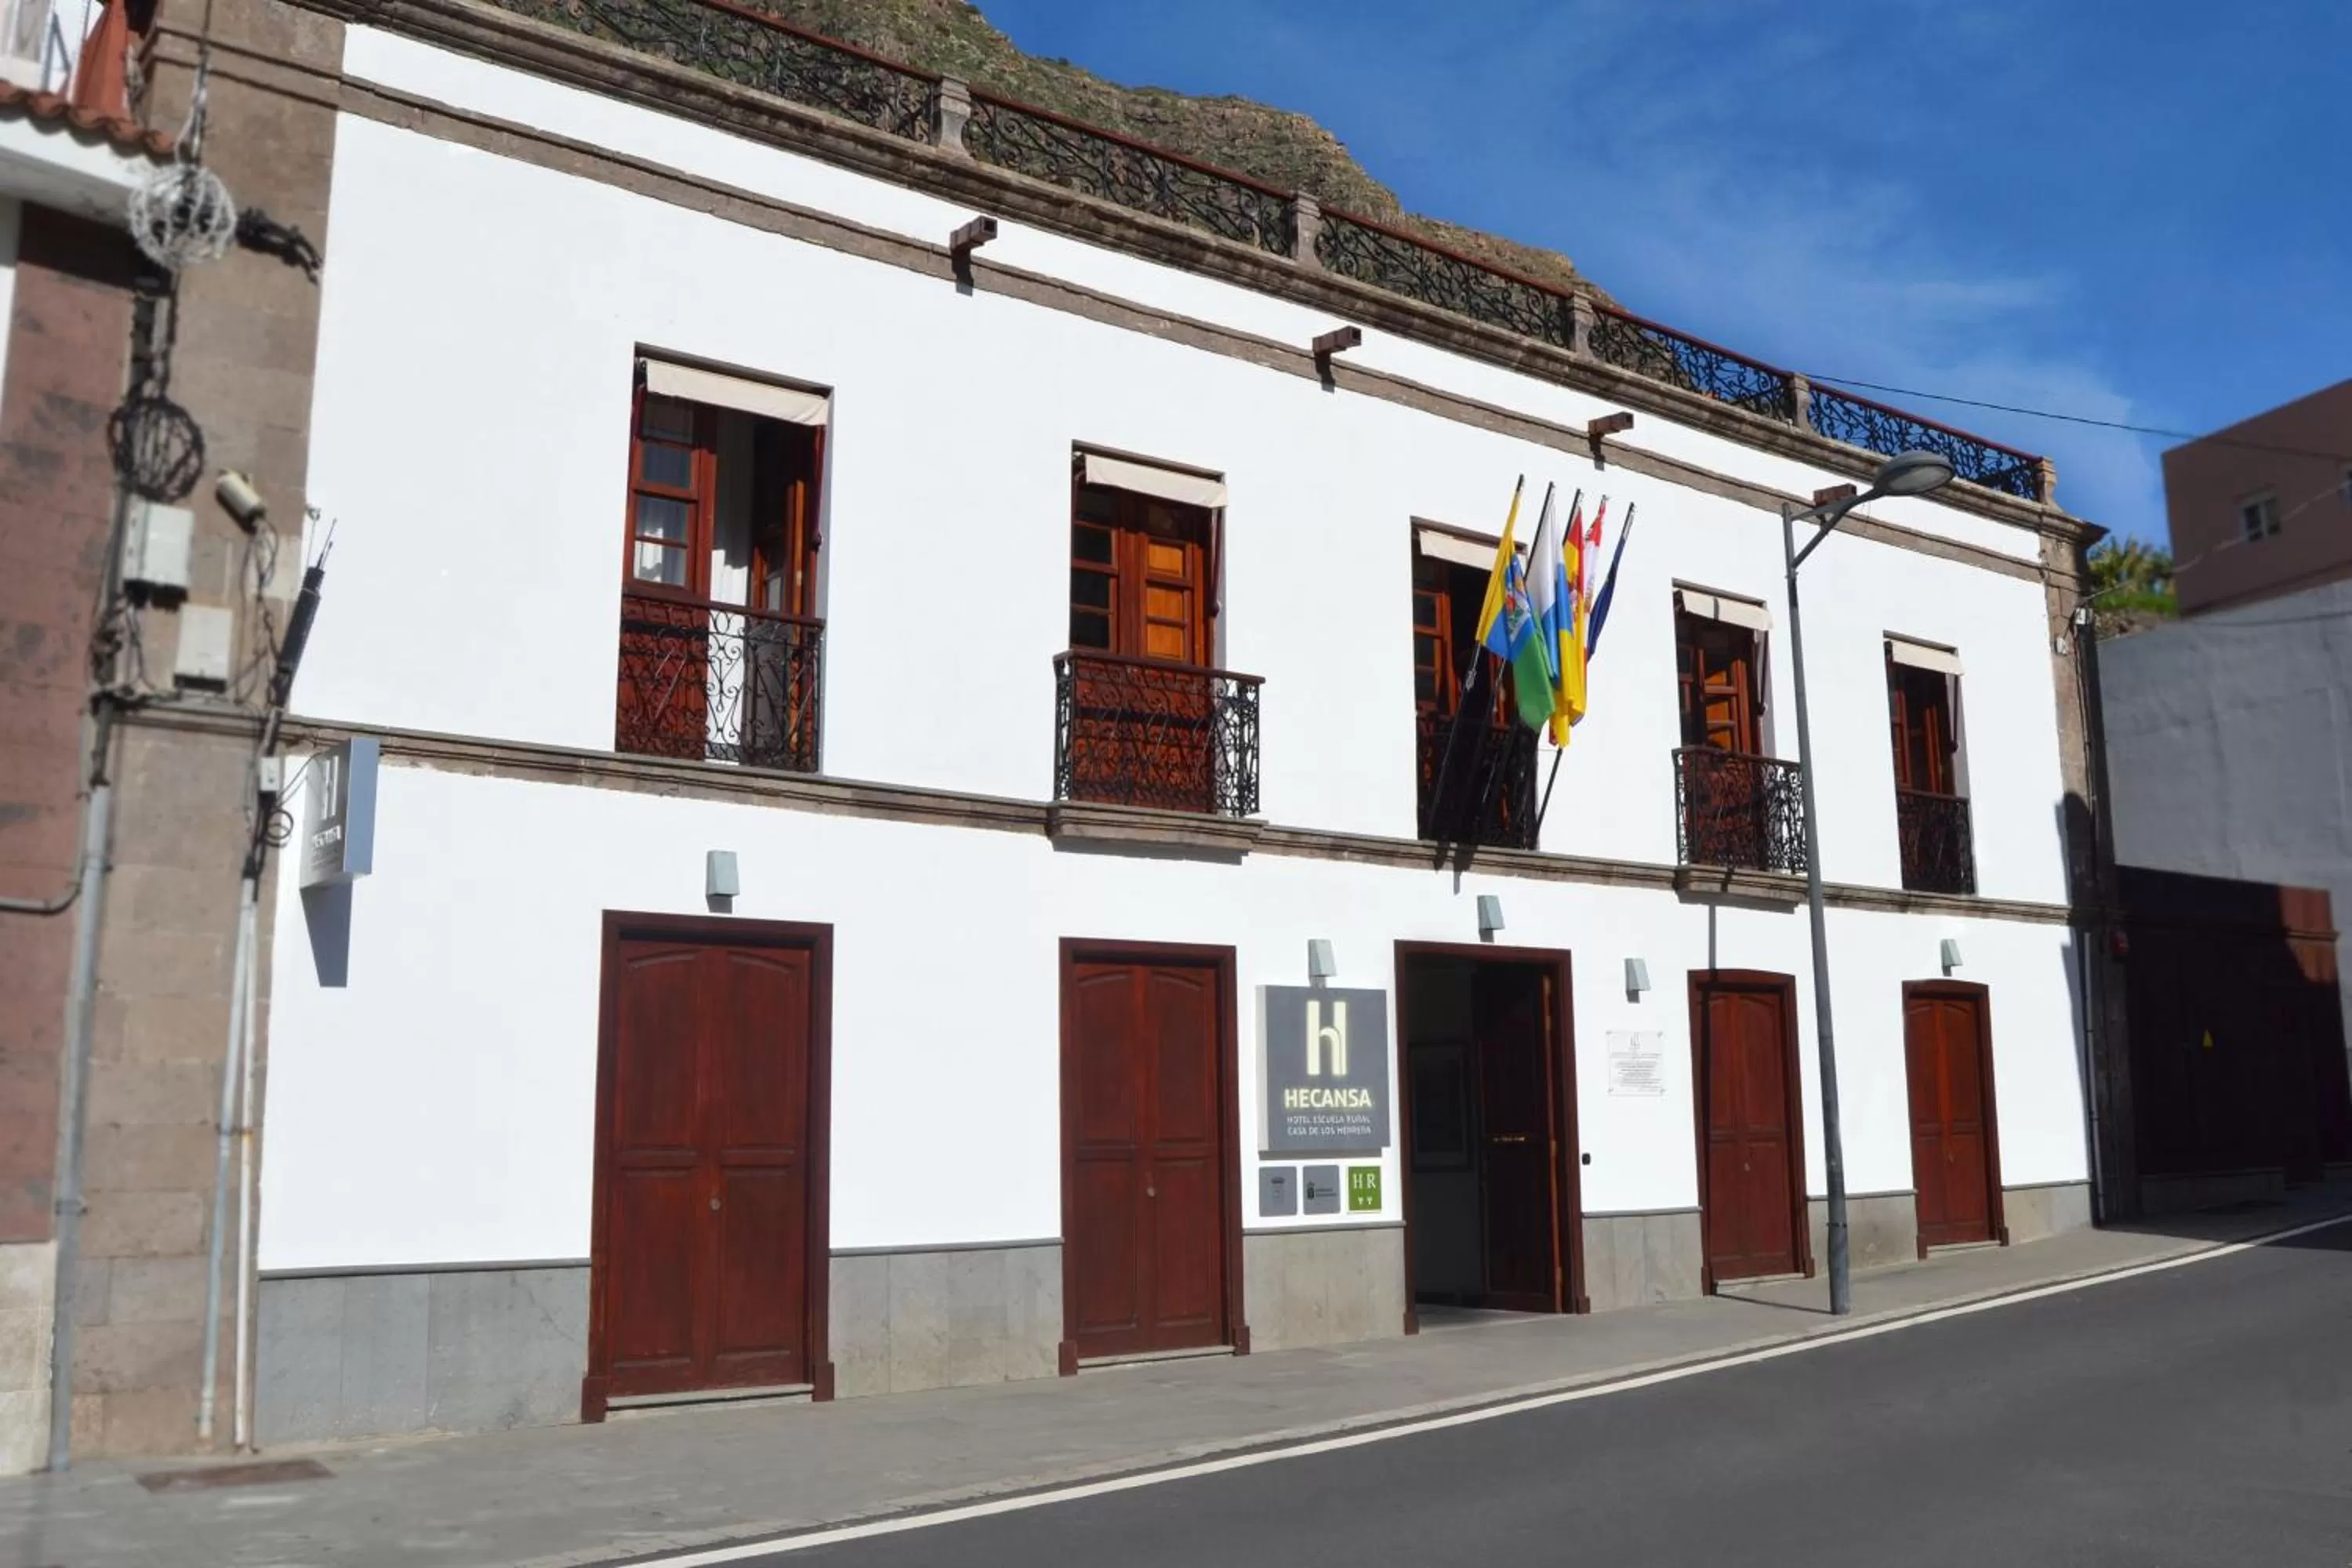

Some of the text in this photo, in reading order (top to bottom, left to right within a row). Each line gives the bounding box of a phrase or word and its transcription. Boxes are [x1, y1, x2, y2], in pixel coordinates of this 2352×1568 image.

[1284, 1087, 1372, 1109] HECANSA
[1287, 1115, 1310, 1123] HOTEL
[1287, 1126, 1307, 1135] CASA
[1308, 1126, 1318, 1135] DE
[1321, 1126, 1335, 1135] LOS
